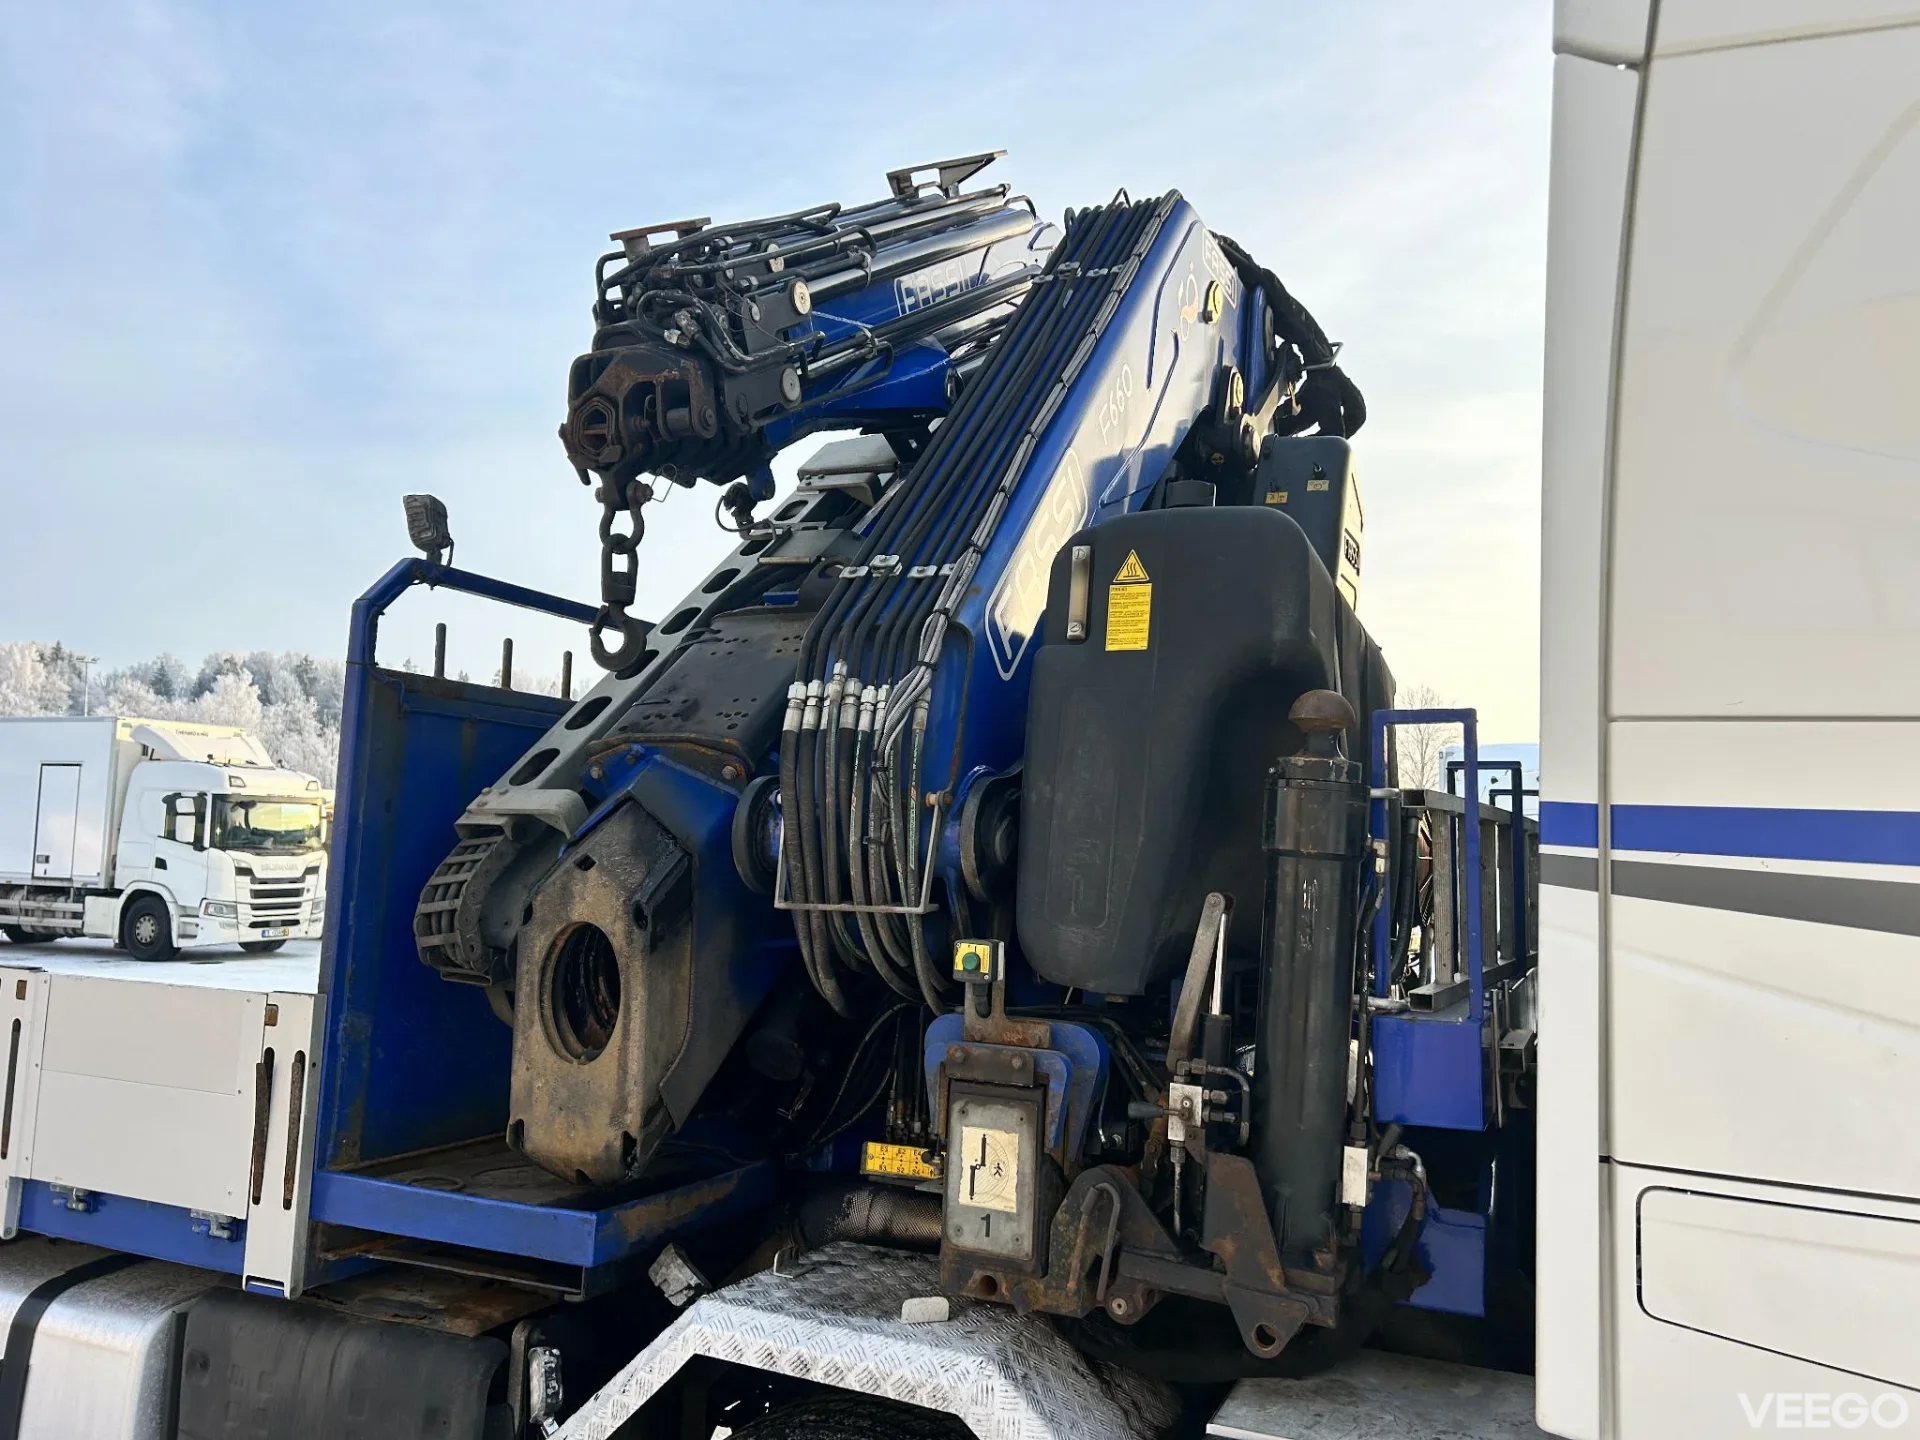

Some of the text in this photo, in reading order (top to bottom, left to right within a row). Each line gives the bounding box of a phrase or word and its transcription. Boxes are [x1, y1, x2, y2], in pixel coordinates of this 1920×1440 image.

[1204, 240, 1236, 302] FASSI
[1099, 364, 1133, 445] F660
[994, 467, 1083, 661] FASSI
[980, 1213, 991, 1237] 1
